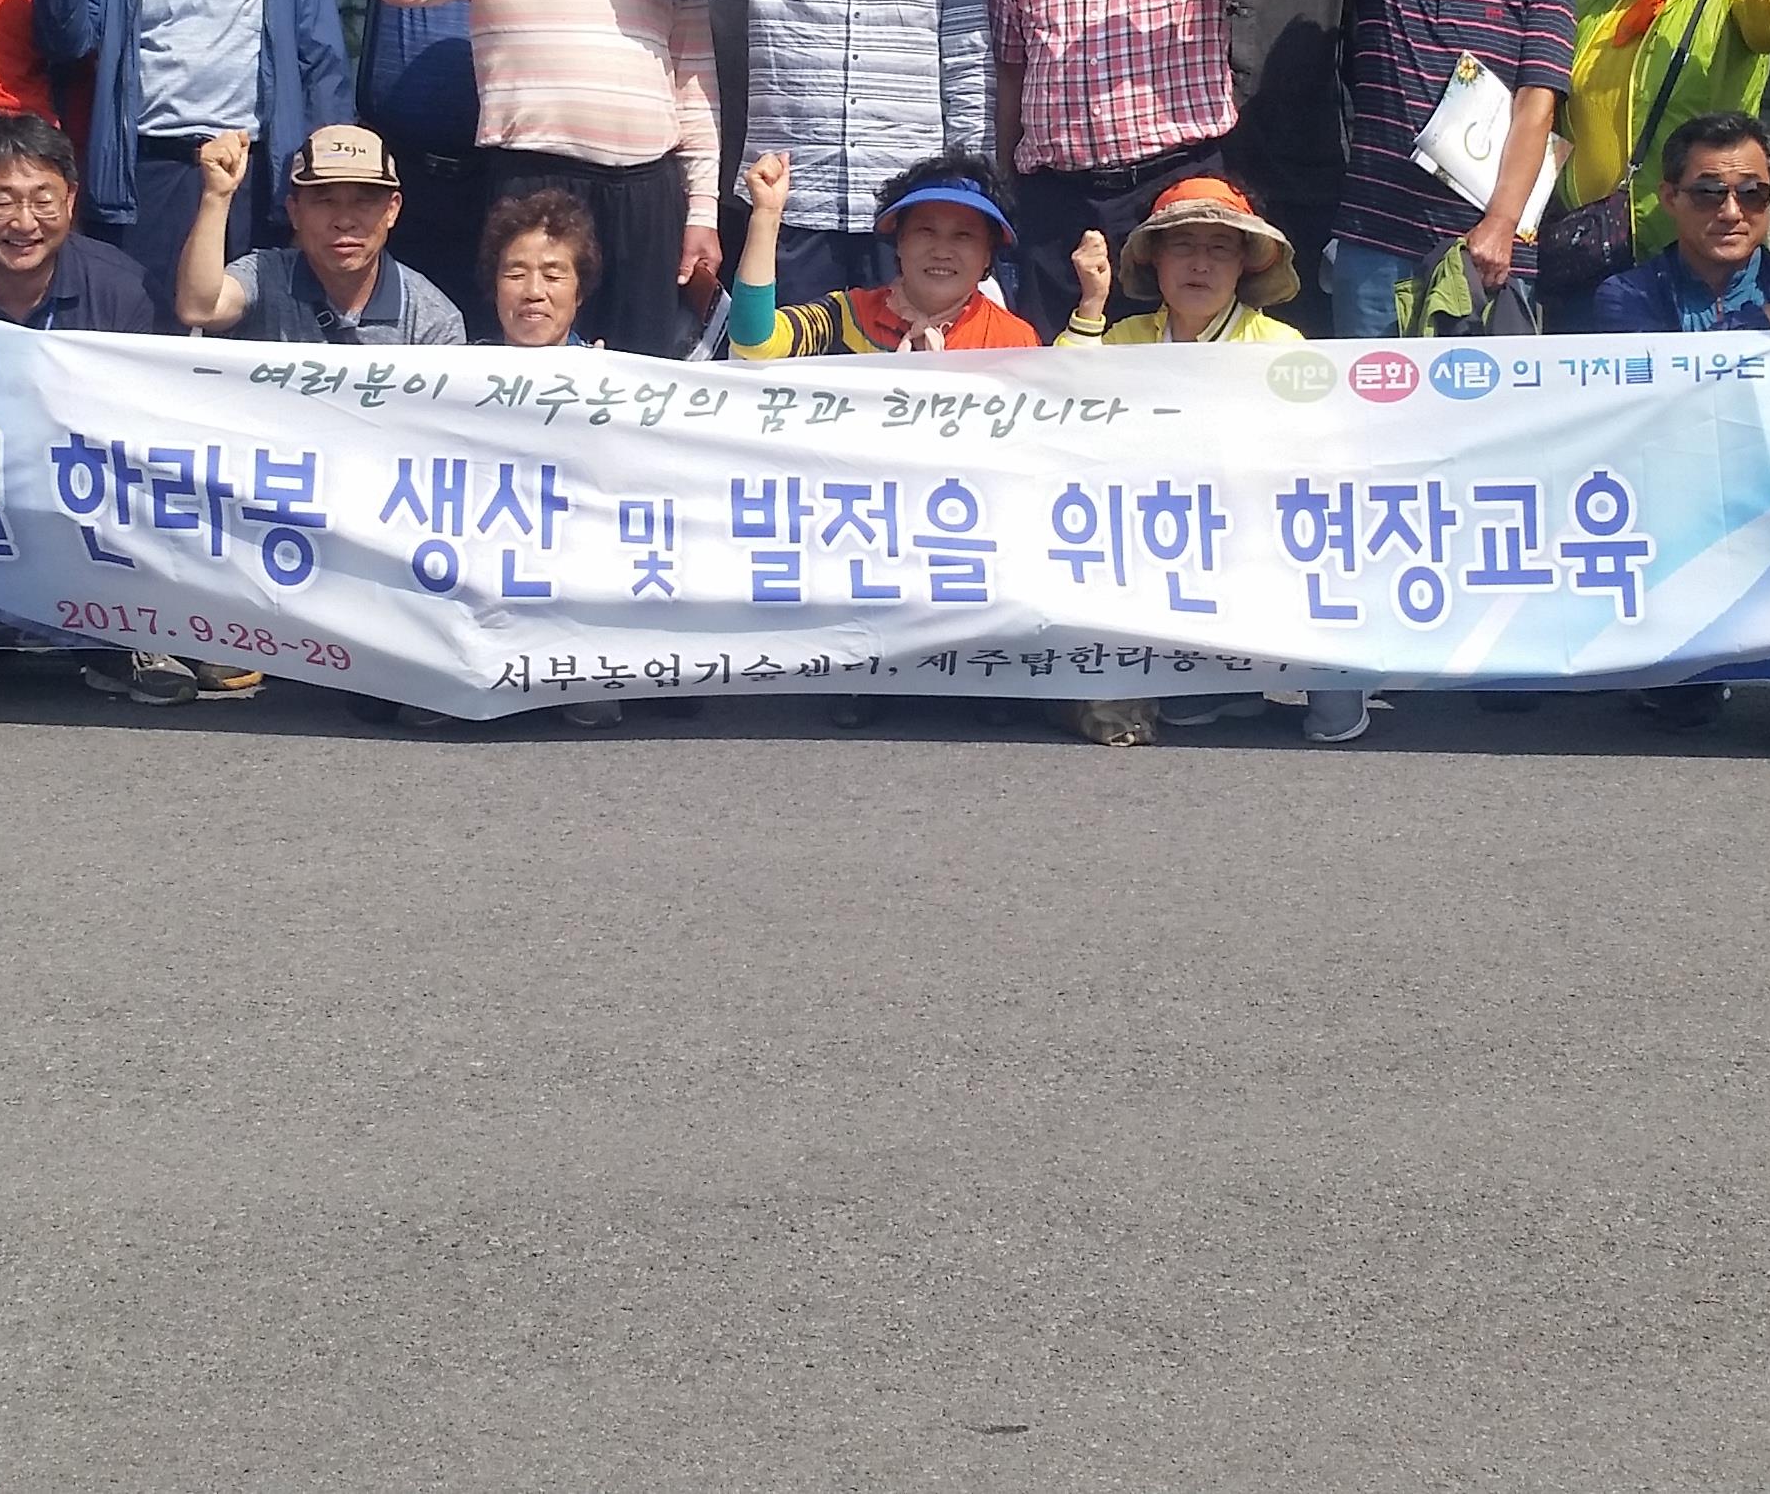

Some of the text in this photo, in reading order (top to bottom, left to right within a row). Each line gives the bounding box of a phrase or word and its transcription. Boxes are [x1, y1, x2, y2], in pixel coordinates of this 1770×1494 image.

[330, 141, 367, 158] Jeju
[1272, 363, 1330, 391] 자연
[1354, 360, 1415, 390] 문화
[1434, 360, 1493, 390] 사람
[1559, 352, 1654, 386] 가치를
[1671, 352, 1766, 383] 키우는
[248, 359, 448, 407] 여러분이
[475, 373, 728, 427] 제주농업의
[756, 387, 856, 435] 꿈과
[882, 387, 1129, 438] 희망입니다
[49, 432, 329, 587] 한라봉
[378, 457, 569, 598] 생산
[618, 498, 675, 598] 및
[730, 477, 998, 602] 발전을
[1047, 479, 1227, 614] 위한
[1275, 470, 1649, 623] 현장교육
[56, 600, 178, 637] 2017.
